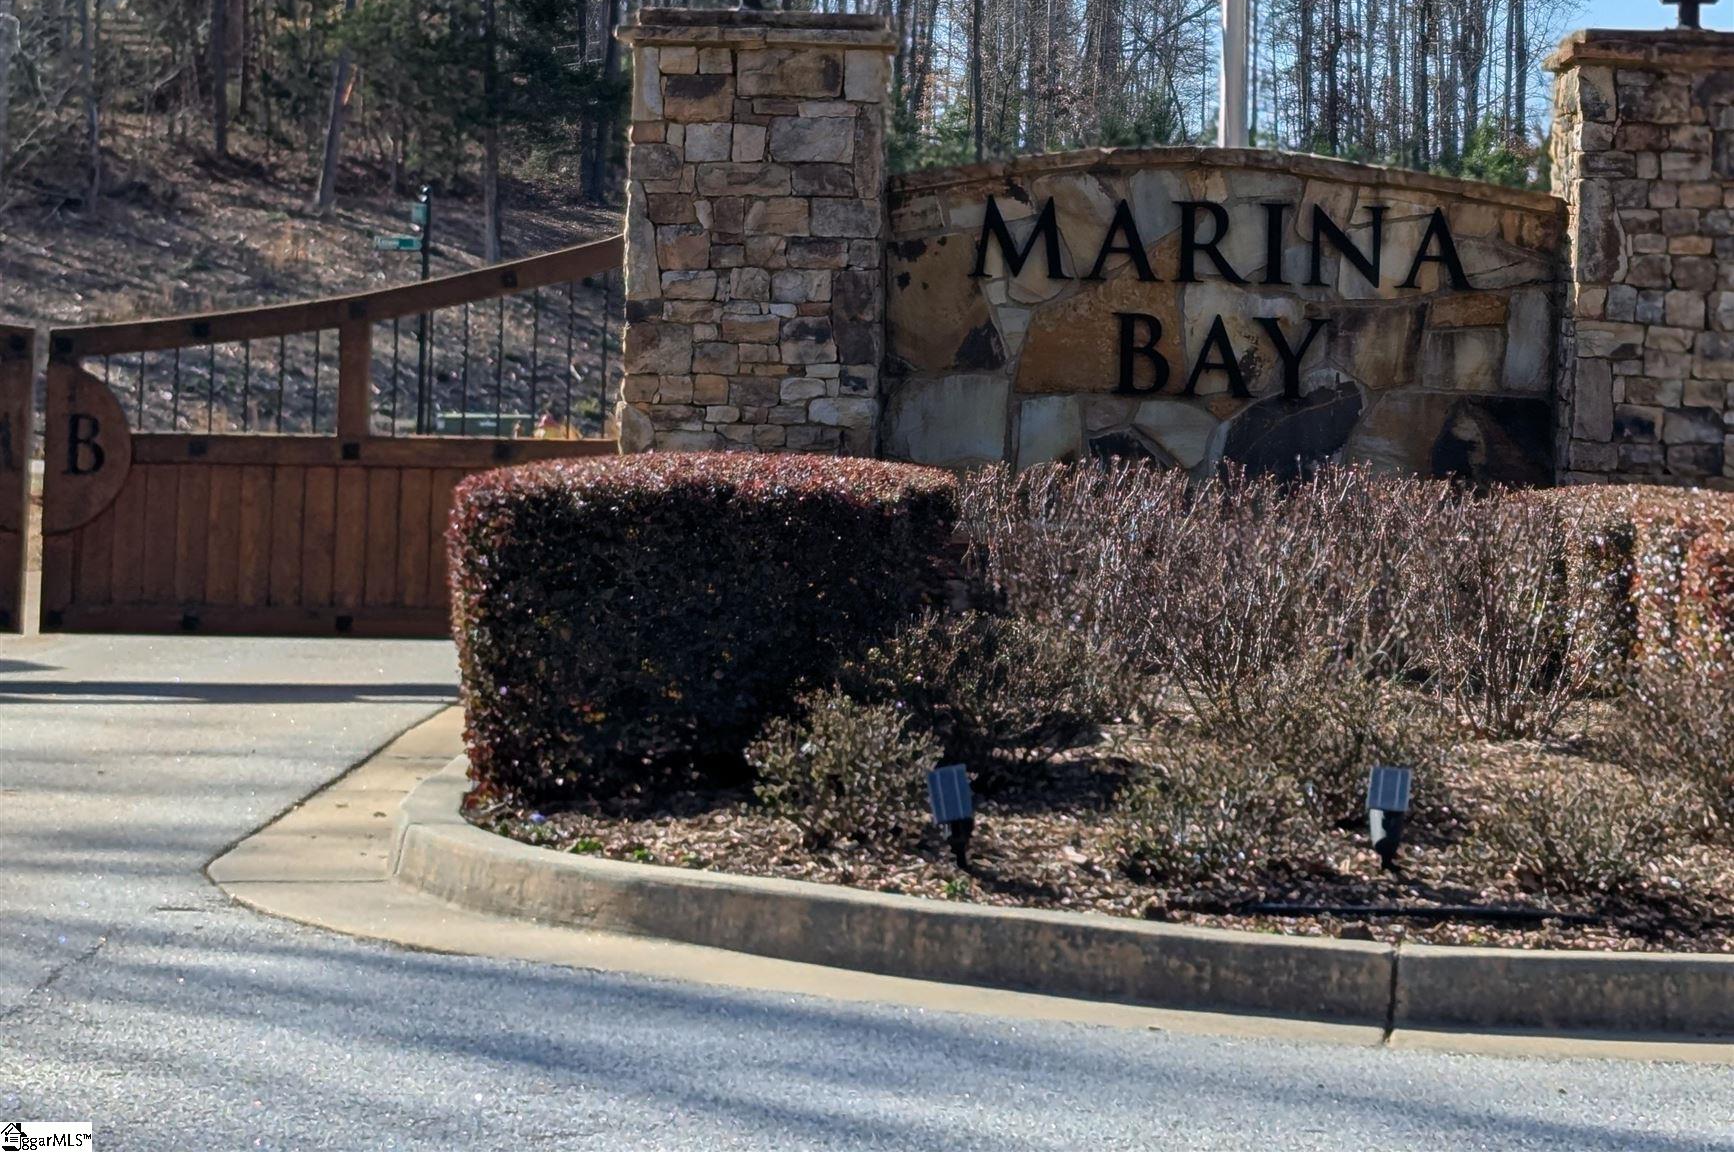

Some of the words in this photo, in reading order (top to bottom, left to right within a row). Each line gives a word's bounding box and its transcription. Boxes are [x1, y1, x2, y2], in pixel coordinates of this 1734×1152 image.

[968, 194, 1473, 290] MARINA
[1112, 312, 1331, 399] BAY
[63, 413, 105, 475] B
